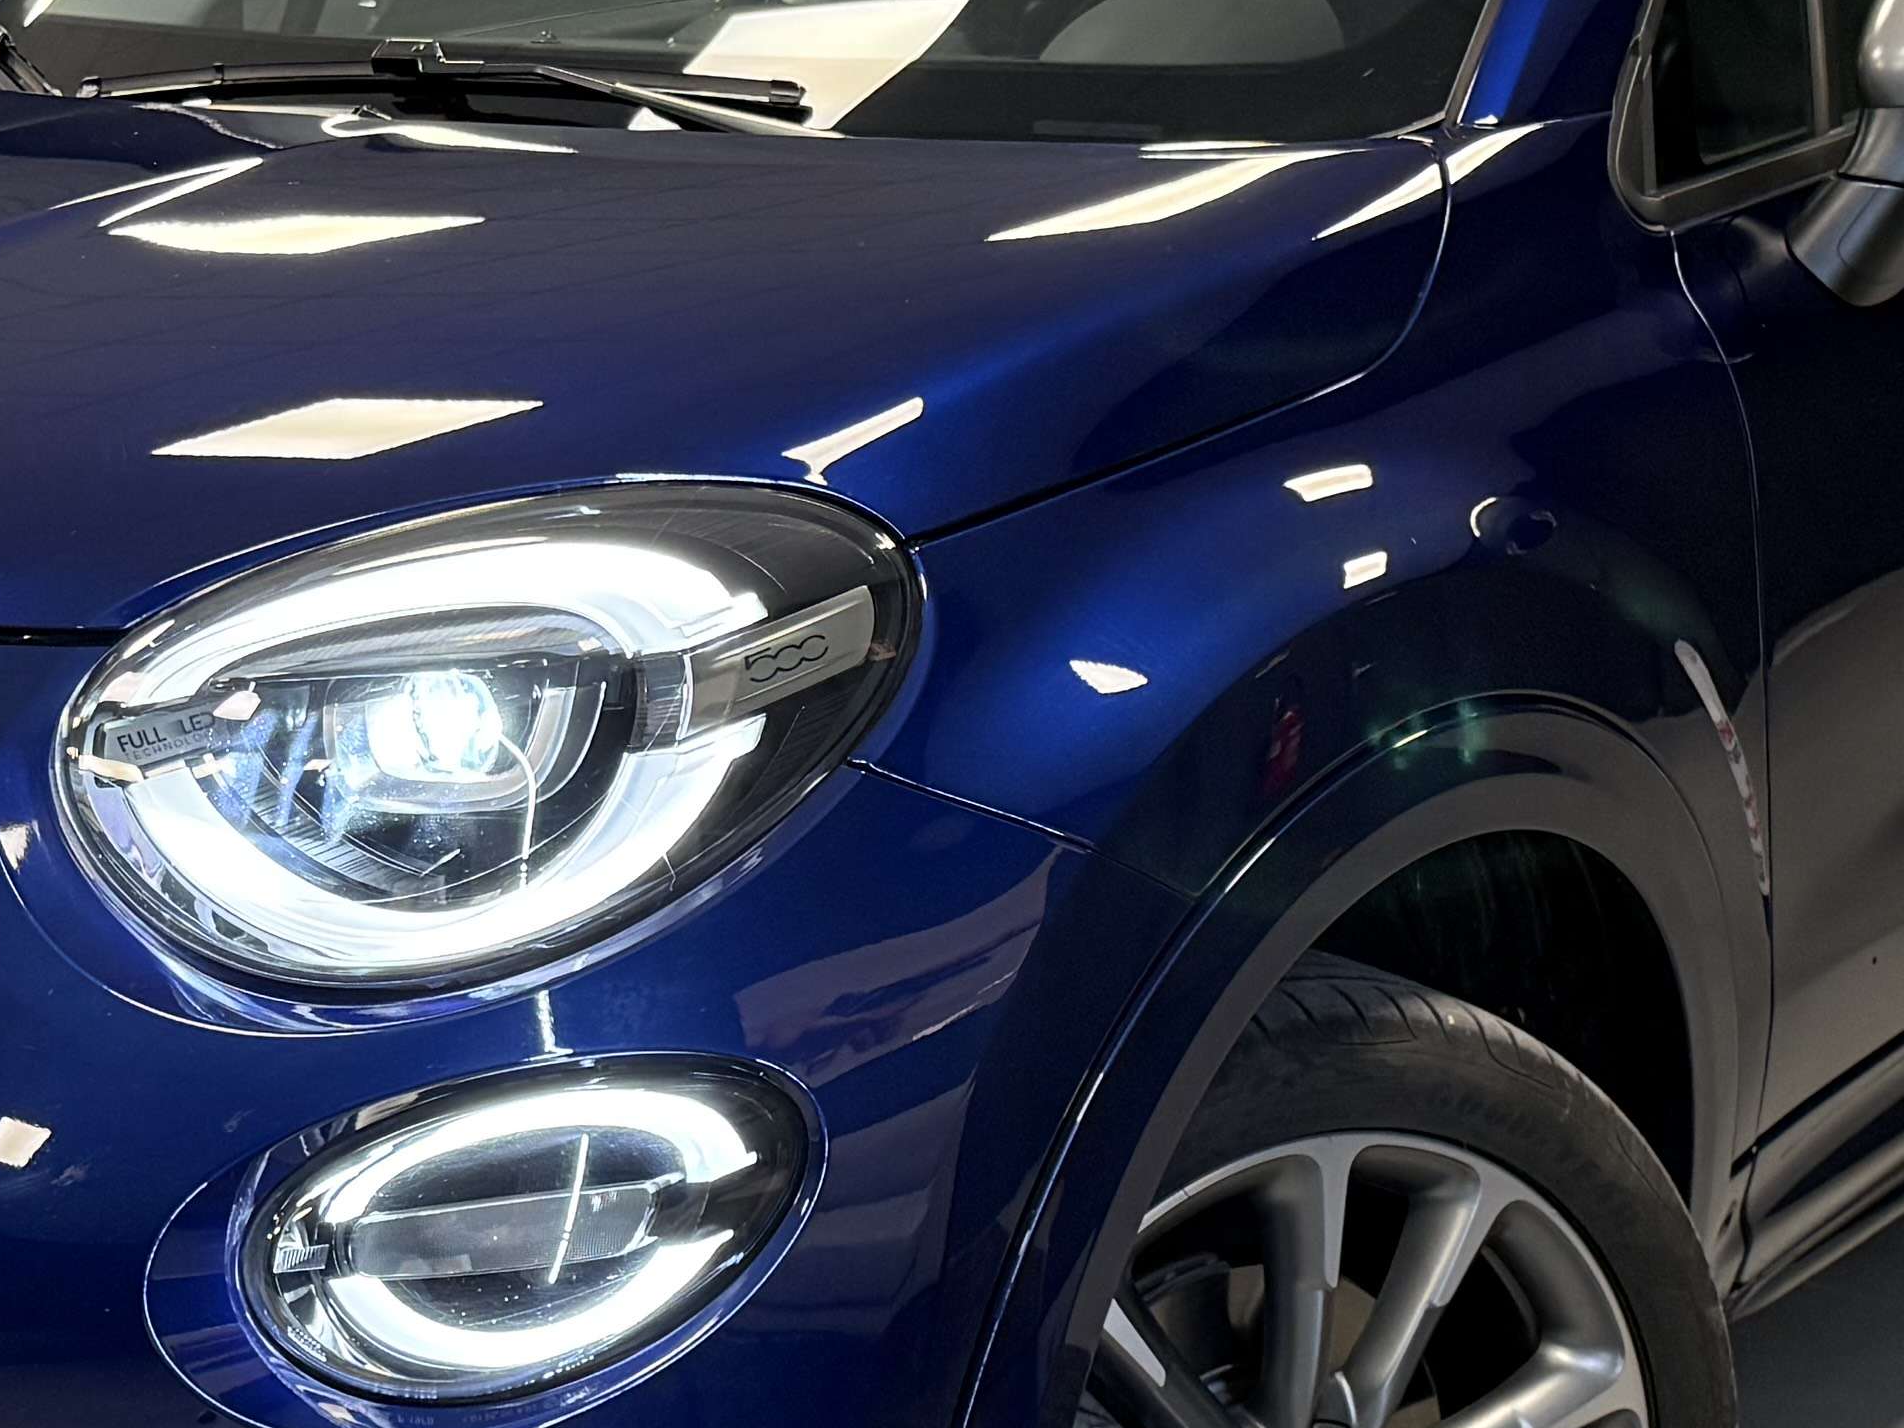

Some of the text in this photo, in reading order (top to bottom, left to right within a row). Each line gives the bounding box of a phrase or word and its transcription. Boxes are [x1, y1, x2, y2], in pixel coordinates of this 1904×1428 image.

[744, 635, 828, 682] 500
[117, 712, 216, 753] FULL LED
